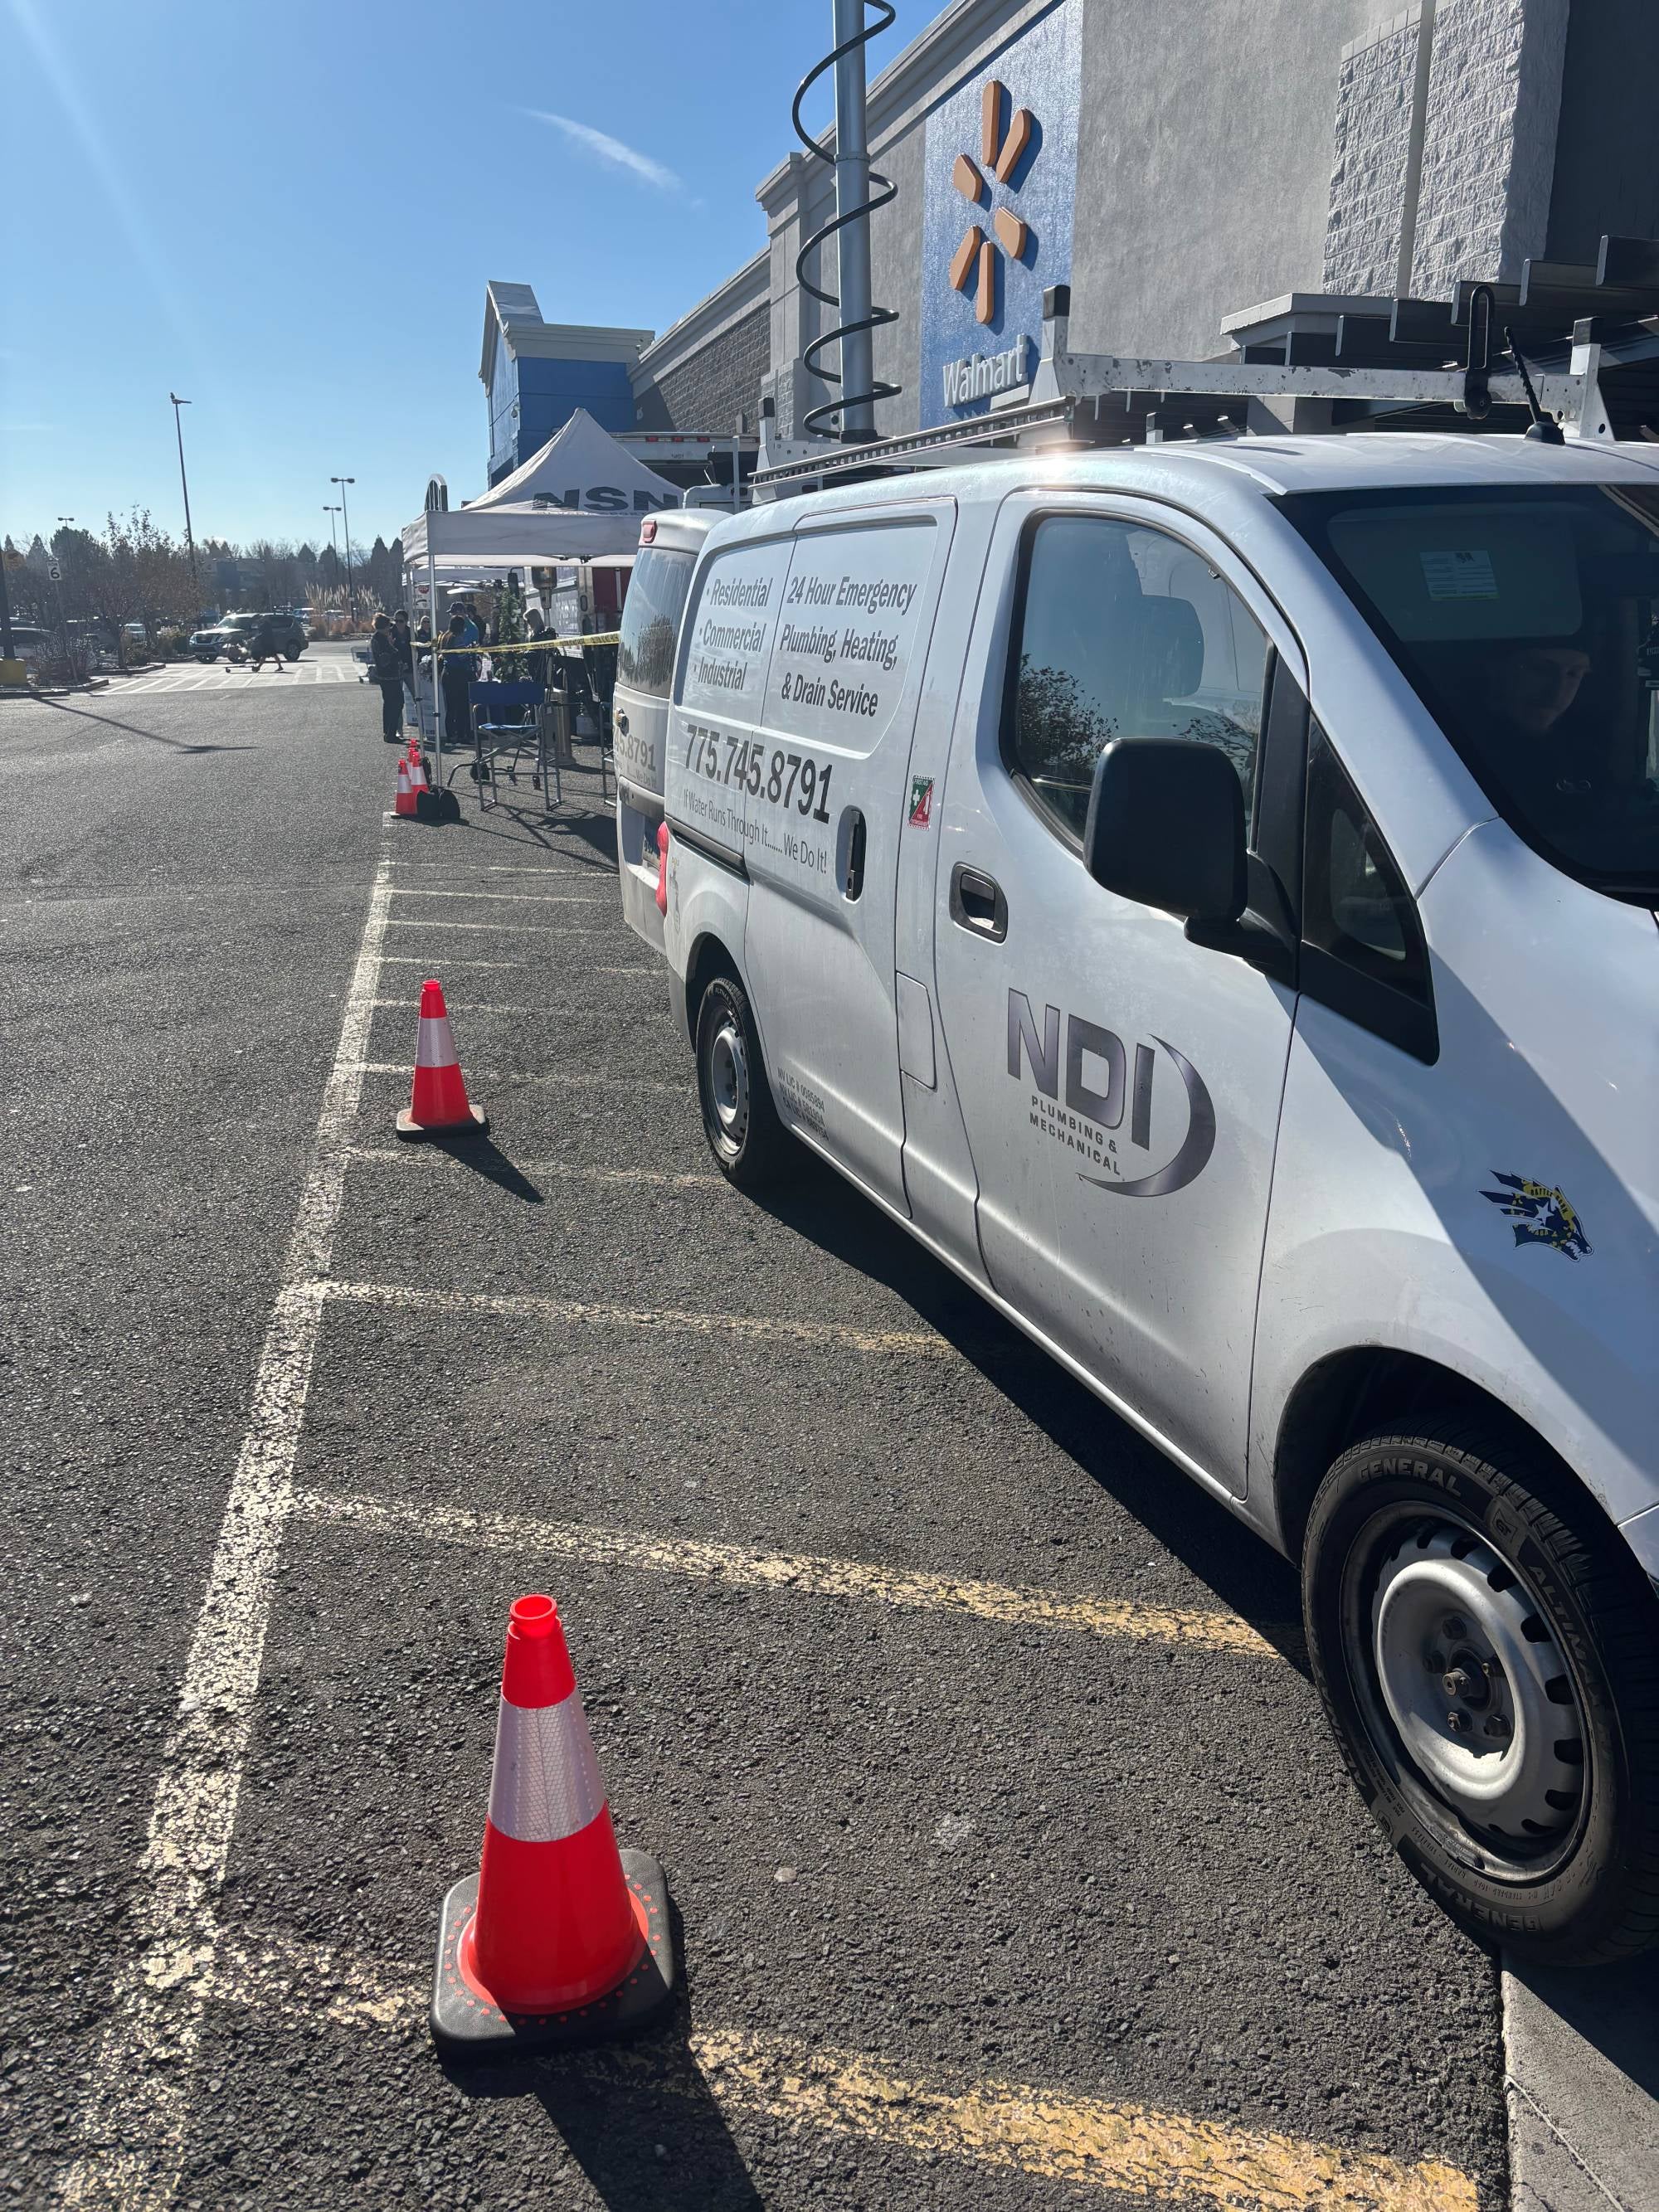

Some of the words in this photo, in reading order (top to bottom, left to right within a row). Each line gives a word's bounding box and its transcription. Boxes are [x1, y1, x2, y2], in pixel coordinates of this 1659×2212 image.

[943, 333, 1028, 407] Walmart
[533, 486, 679, 511] NSN
[51, 567, 60, 579] 6
[710, 577, 773, 607] Residential
[786, 576, 806, 604] 24
[805, 576, 836, 605] Hour
[836, 576, 917, 615] Emergency
[703, 619, 766, 652] Commercial
[780, 624, 838, 664] Plumbing,
[840, 628, 898, 670] Heating,
[698, 657, 747, 690] Industrial
[781, 672, 791, 700] &
[792, 674, 825, 707] Drain
[828, 679, 878, 717] Service
[686, 723, 832, 824] 775.745.8791
[684, 789, 689, 808] If
[688, 789, 708, 817] Water
[708, 800, 727, 827] Runs
[727, 808, 761, 845] Through
[783, 833, 798, 861] We
[800, 840, 815, 868] Do
[817, 847, 828, 875] It!
[1008, 987, 1155, 1151] NDI
[1029, 1111, 1121, 1176] MECHANICAL
[1031, 1095, 1104, 1146] PLUMBING
[1108, 1138, 1118, 1155] &
[1360, 1458, 1462, 1497] GENERAL
[1420, 1862, 1541, 1931] GENERAL
